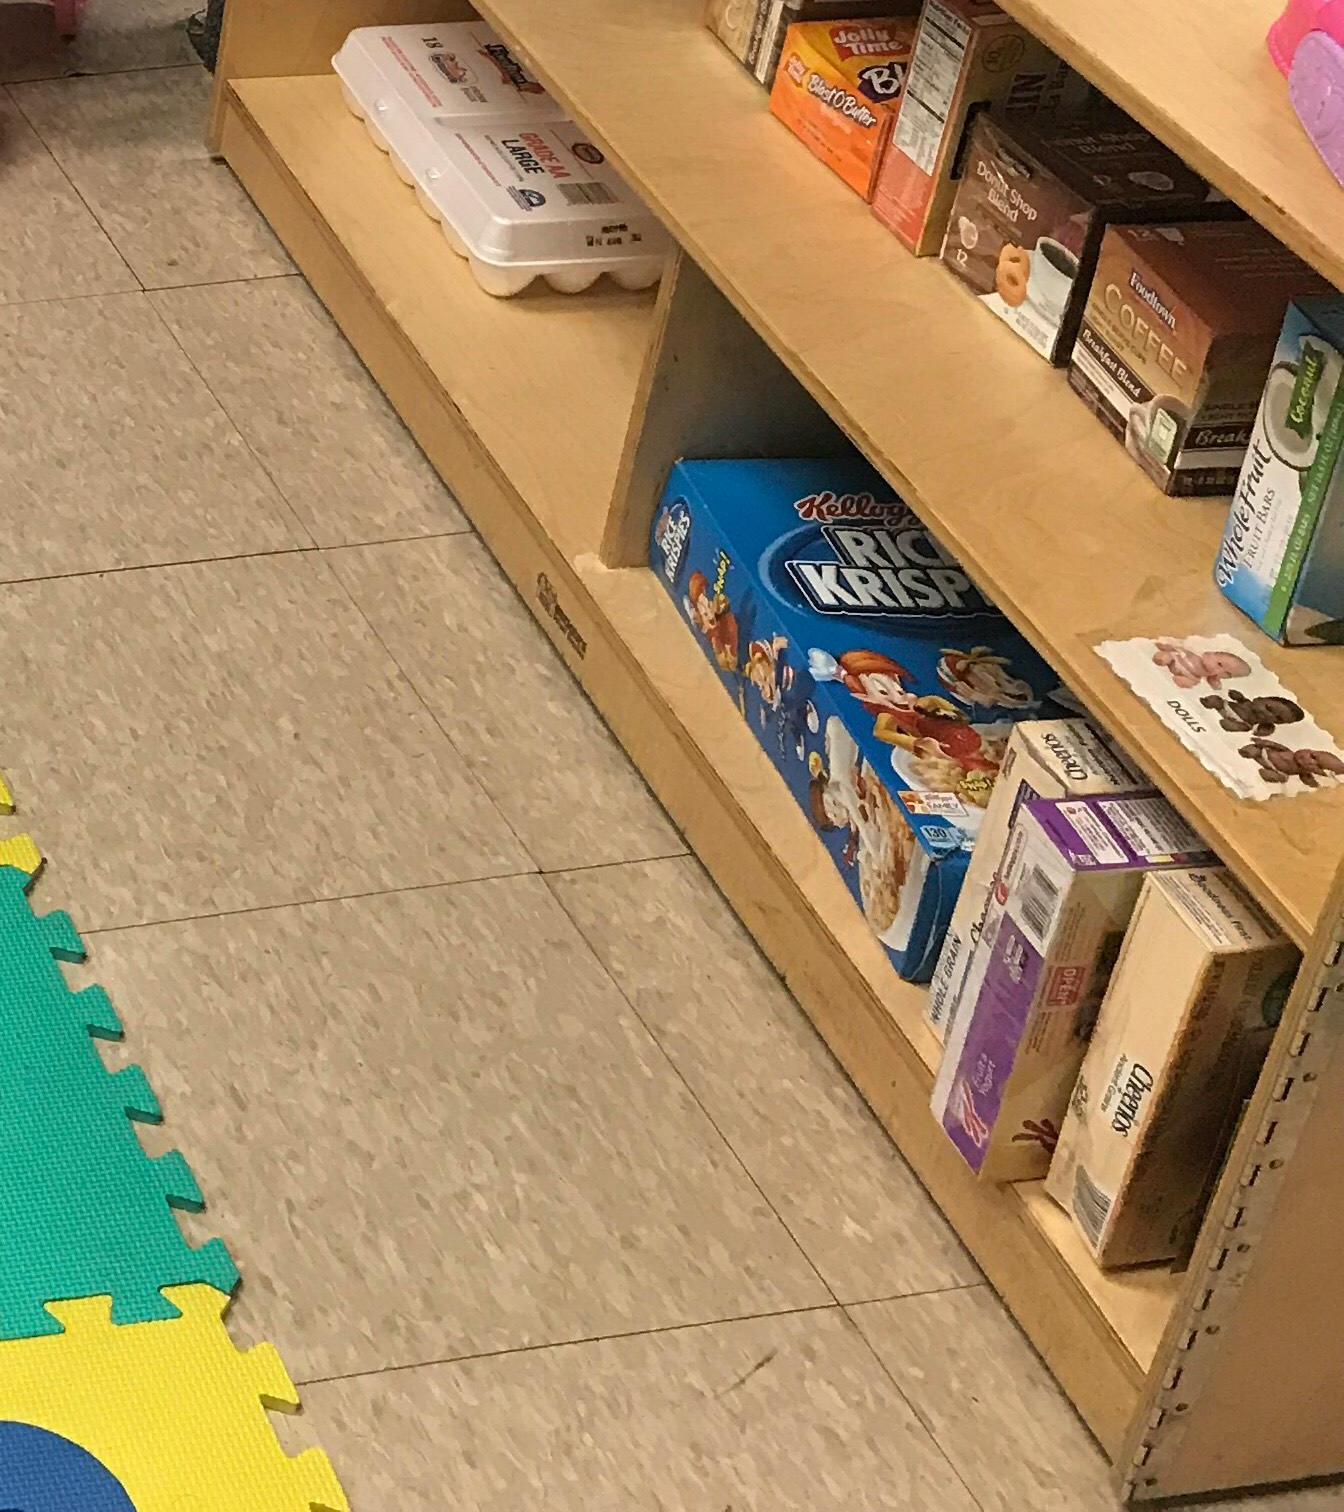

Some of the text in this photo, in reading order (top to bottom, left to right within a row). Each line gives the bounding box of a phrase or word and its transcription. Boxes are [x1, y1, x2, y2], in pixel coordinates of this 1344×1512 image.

[421, 36, 444, 49] 18
[834, 29, 892, 45] Jolly
[845, 39, 903, 55] Time
[807, 74, 837, 102] Blast
[842, 96, 877, 126] Butter
[501, 139, 546, 176] LARGE
[518, 132, 559, 166] GRADE
[976, 160, 1010, 192] Donut
[1010, 188, 1038, 221] Shop
[987, 188, 1019, 223] Blend
[956, 248, 968, 268] 12
[1128, 268, 1176, 330] Foodtown
[1105, 283, 1188, 383] COFFEE
[1082, 328, 1117, 372] Breakfast
[1116, 367, 1142, 399] Blend
[1290, 354, 1320, 424] Coconut
[1194, 429, 1250, 446] Break
[661, 515, 677, 556] RICE
[665, 510, 691, 583] KRISPIES
[1217, 502, 1251, 588] Whole
[1243, 486, 1277, 570] FRUIT BARS
[1166, 700, 1207, 734] DOLLS
[1041, 732, 1088, 781] Cheerios
[924, 827, 947, 839] 130
[943, 934, 962, 977] GRAIN
[1111, 1063, 1154, 1138] Cheerios
